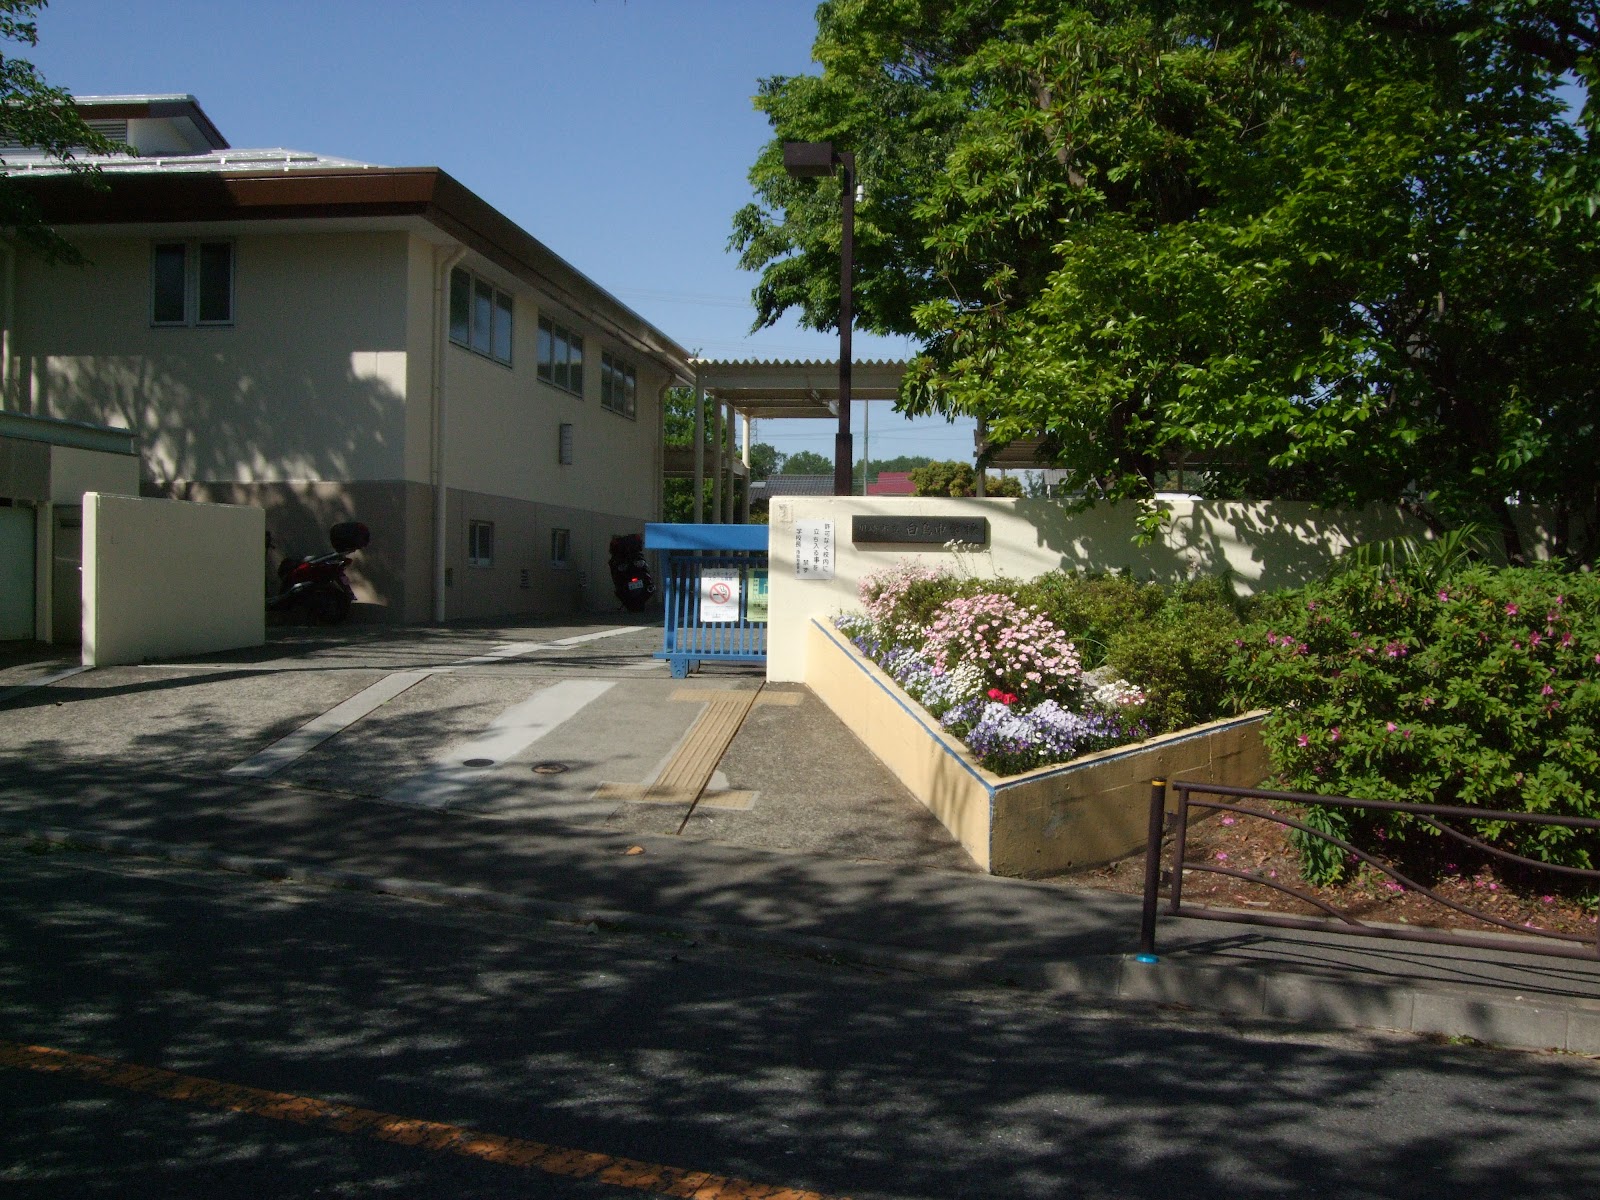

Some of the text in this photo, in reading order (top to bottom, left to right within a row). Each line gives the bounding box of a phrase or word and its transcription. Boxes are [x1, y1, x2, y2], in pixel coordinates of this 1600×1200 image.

[812, 528, 820, 572] 立ち入る事を
[822, 523, 831, 573] 許可なく校内に
